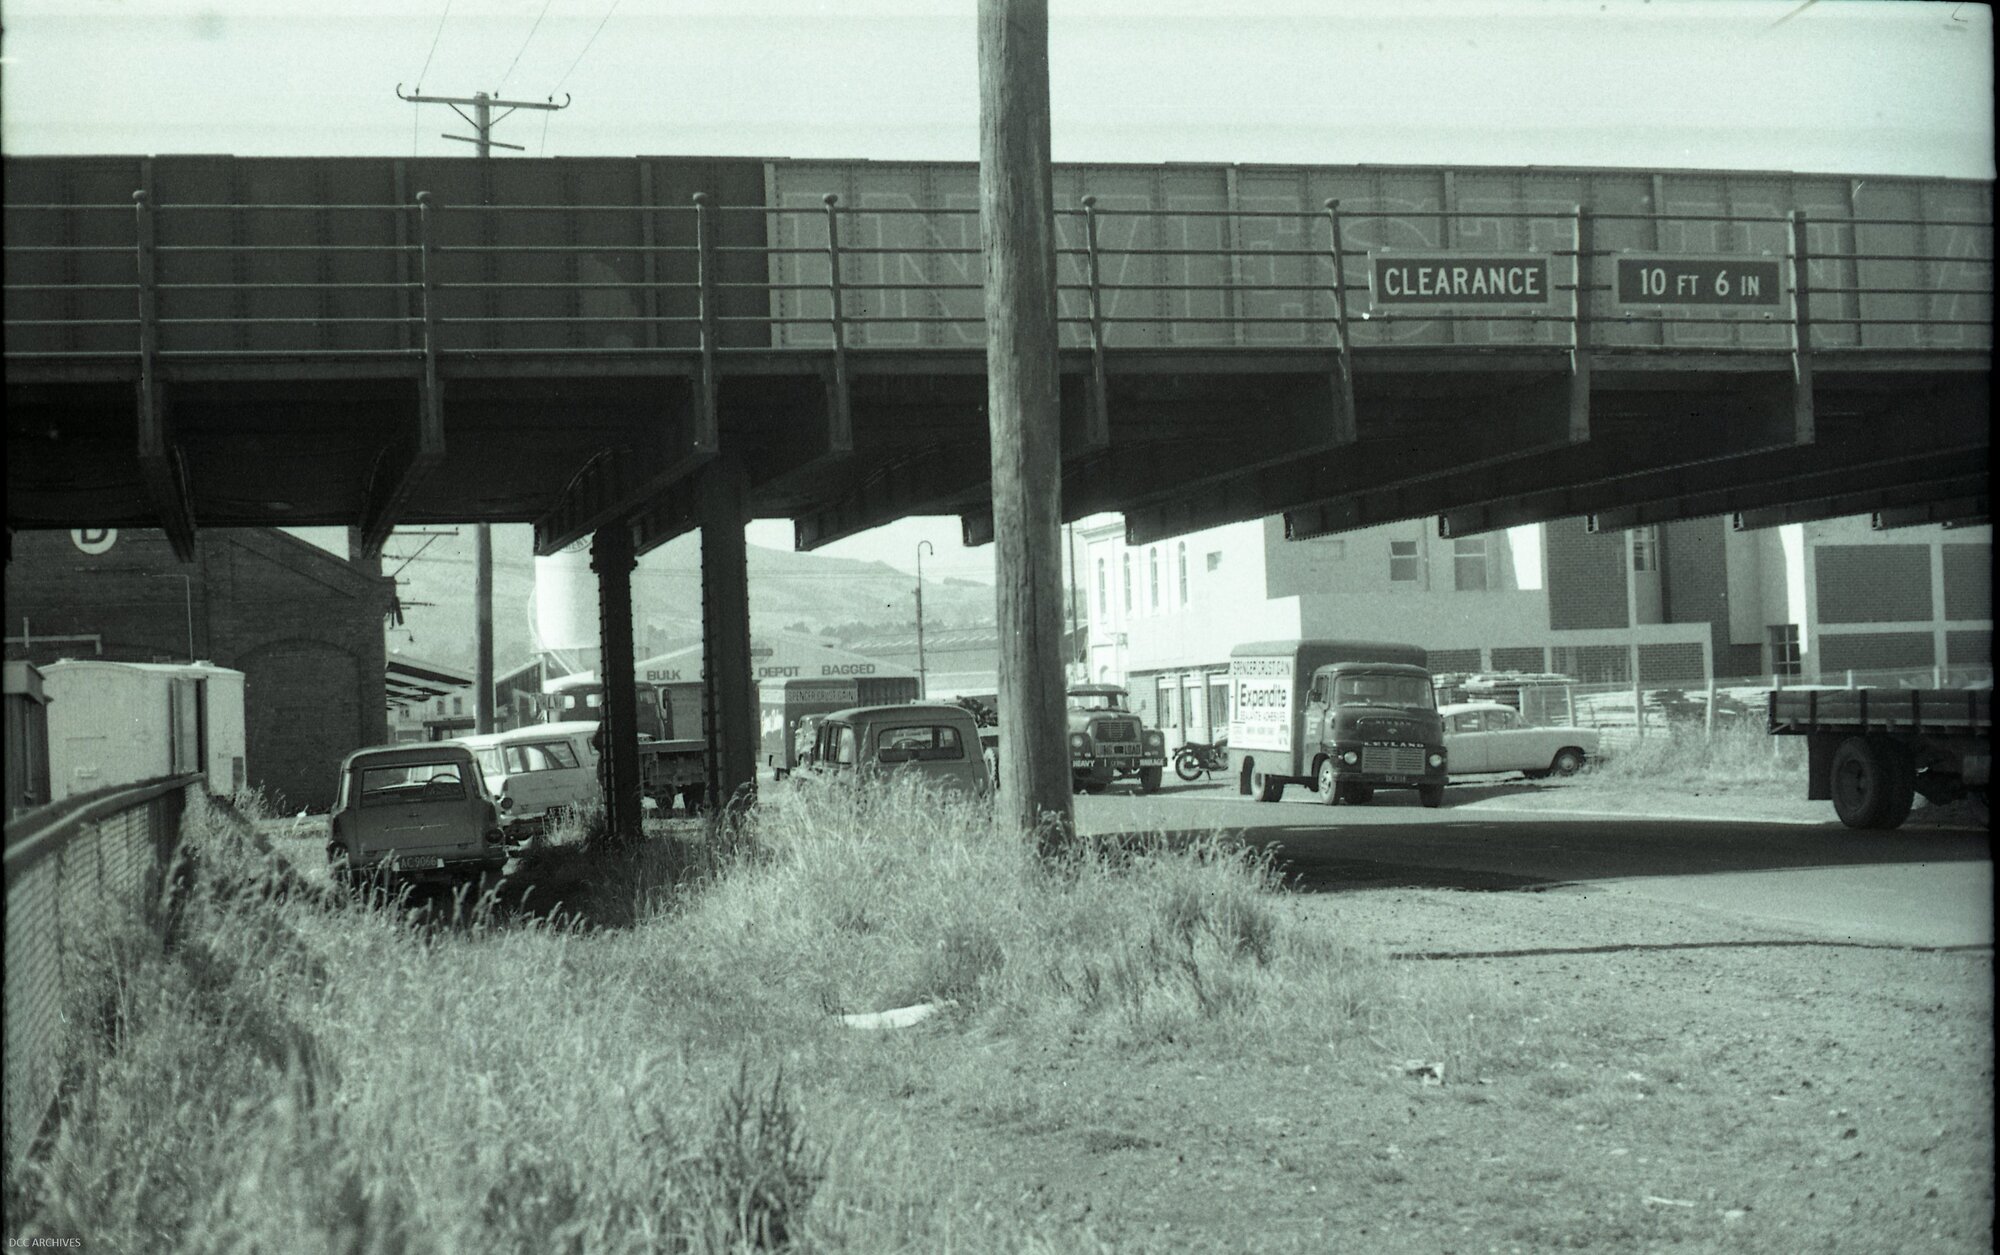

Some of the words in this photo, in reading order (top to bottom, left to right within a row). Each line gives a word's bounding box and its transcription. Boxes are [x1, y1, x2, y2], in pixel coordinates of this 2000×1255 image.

[1384, 266, 1541, 297] CLEARANCE
[1639, 267, 1667, 297] 10
[1677, 274, 1698, 297] FT
[1714, 269, 1731, 298] 6
[1740, 274, 1761, 298] IN
[646, 669, 681, 681] BULK
[758, 666, 800, 678] DEPOT
[821, 663, 876, 676] BAGGED
[1240, 683, 1287, 709] Expandite
[1072, 760, 1095, 768] HEAVY
